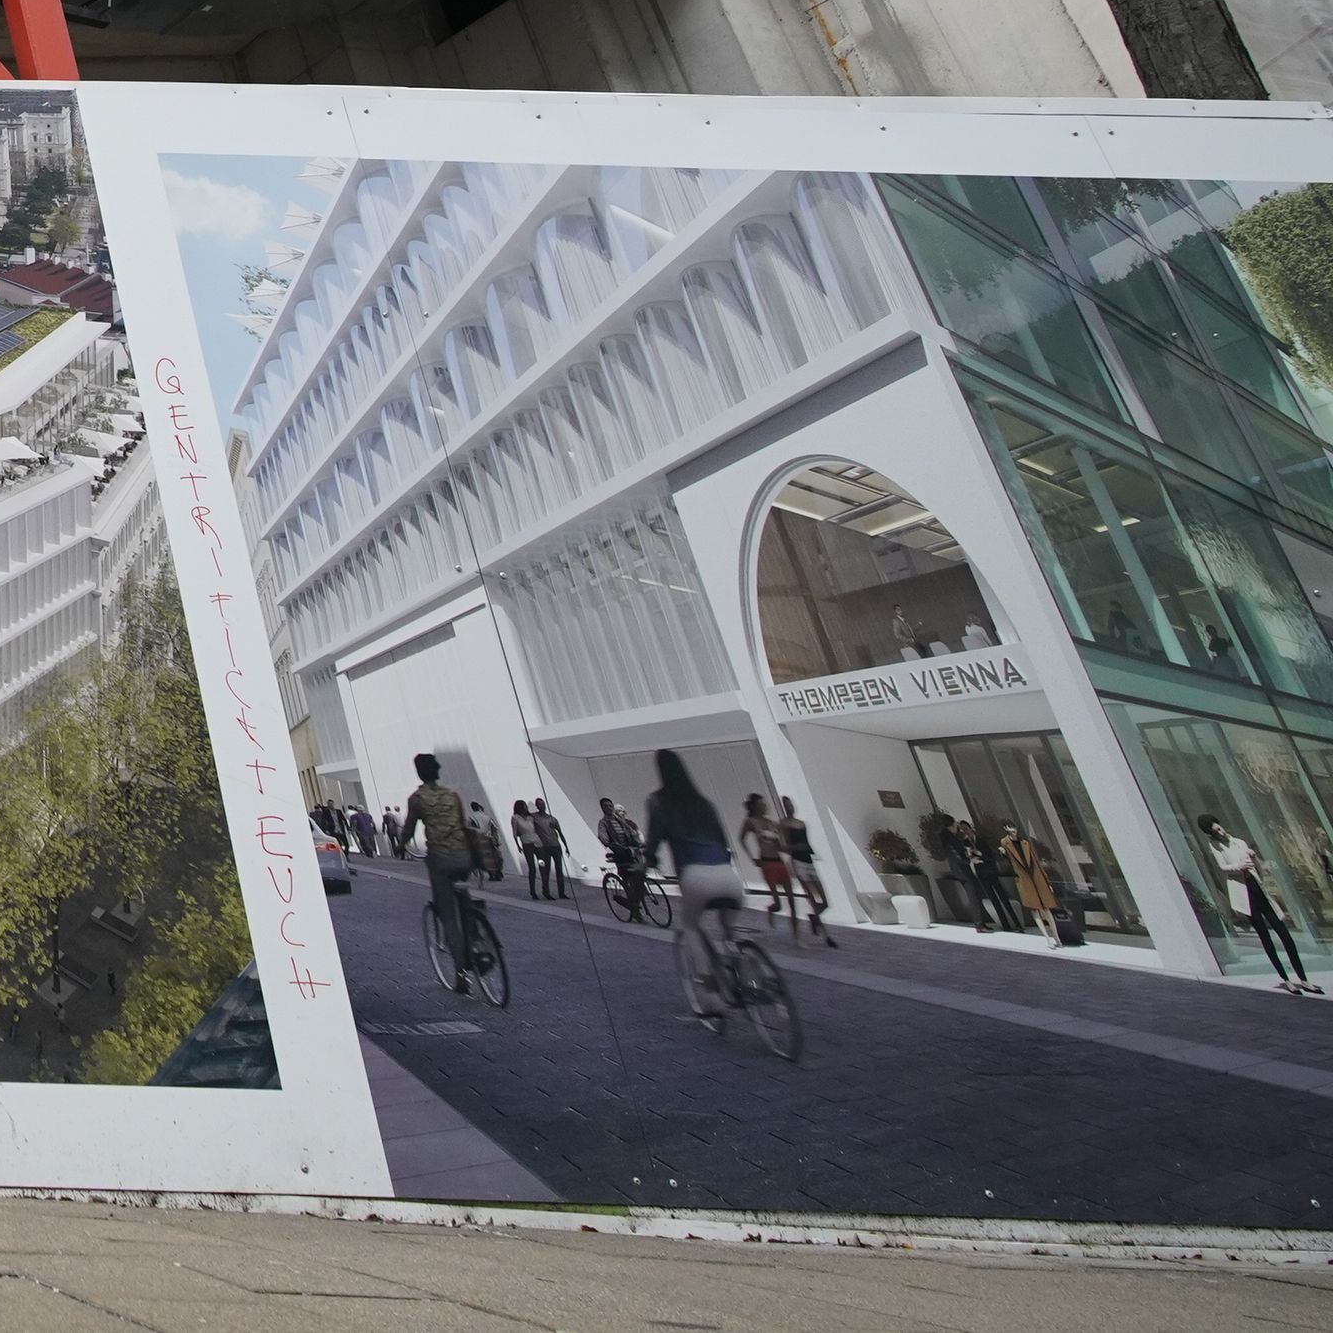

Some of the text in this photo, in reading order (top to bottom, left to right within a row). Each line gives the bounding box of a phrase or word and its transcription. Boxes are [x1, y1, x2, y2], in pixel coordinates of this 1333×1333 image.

[778, 657, 1029, 716] THOMPSON VIENNA
[255, 814, 332, 1002] EUCH
